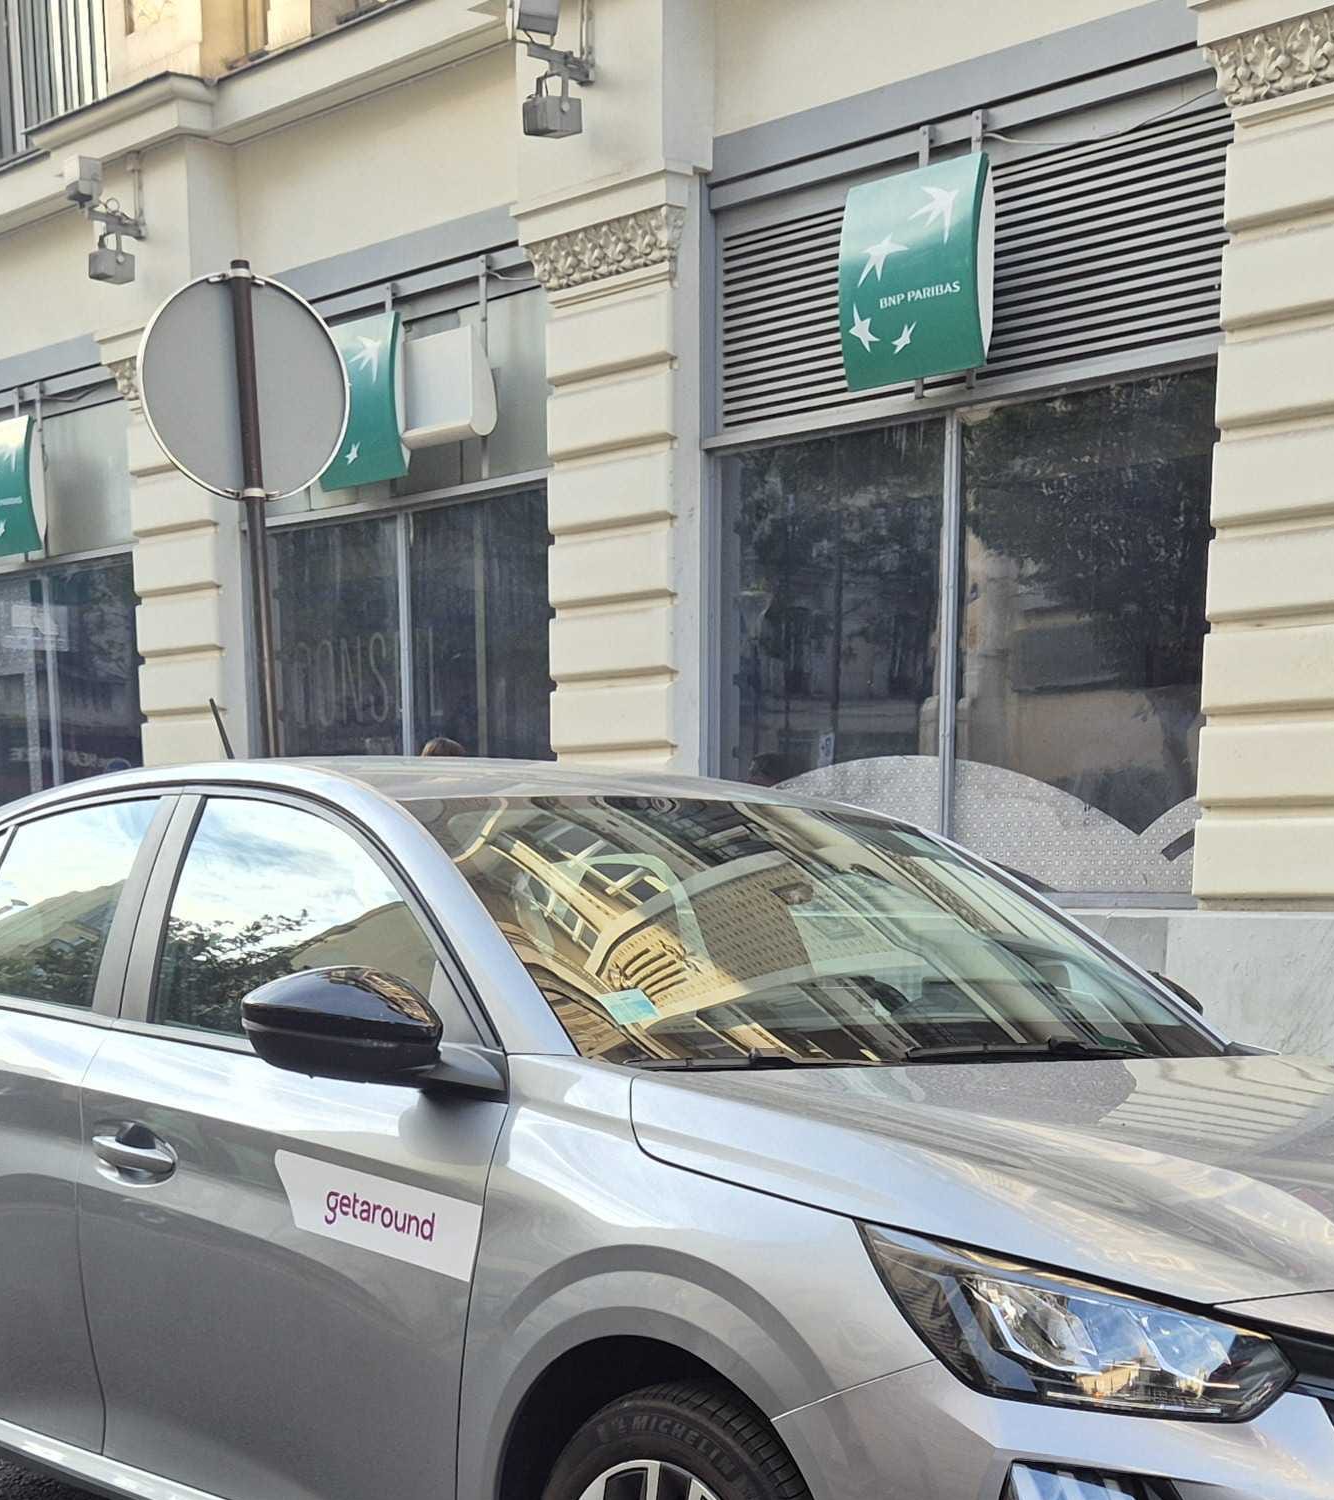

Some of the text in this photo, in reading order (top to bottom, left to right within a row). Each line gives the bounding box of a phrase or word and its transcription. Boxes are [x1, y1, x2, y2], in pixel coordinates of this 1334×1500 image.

[879, 280, 961, 310] BNP PARIBAS
[324, 1191, 436, 1242] getaround
[632, 1414, 739, 1482] MICHELIN
